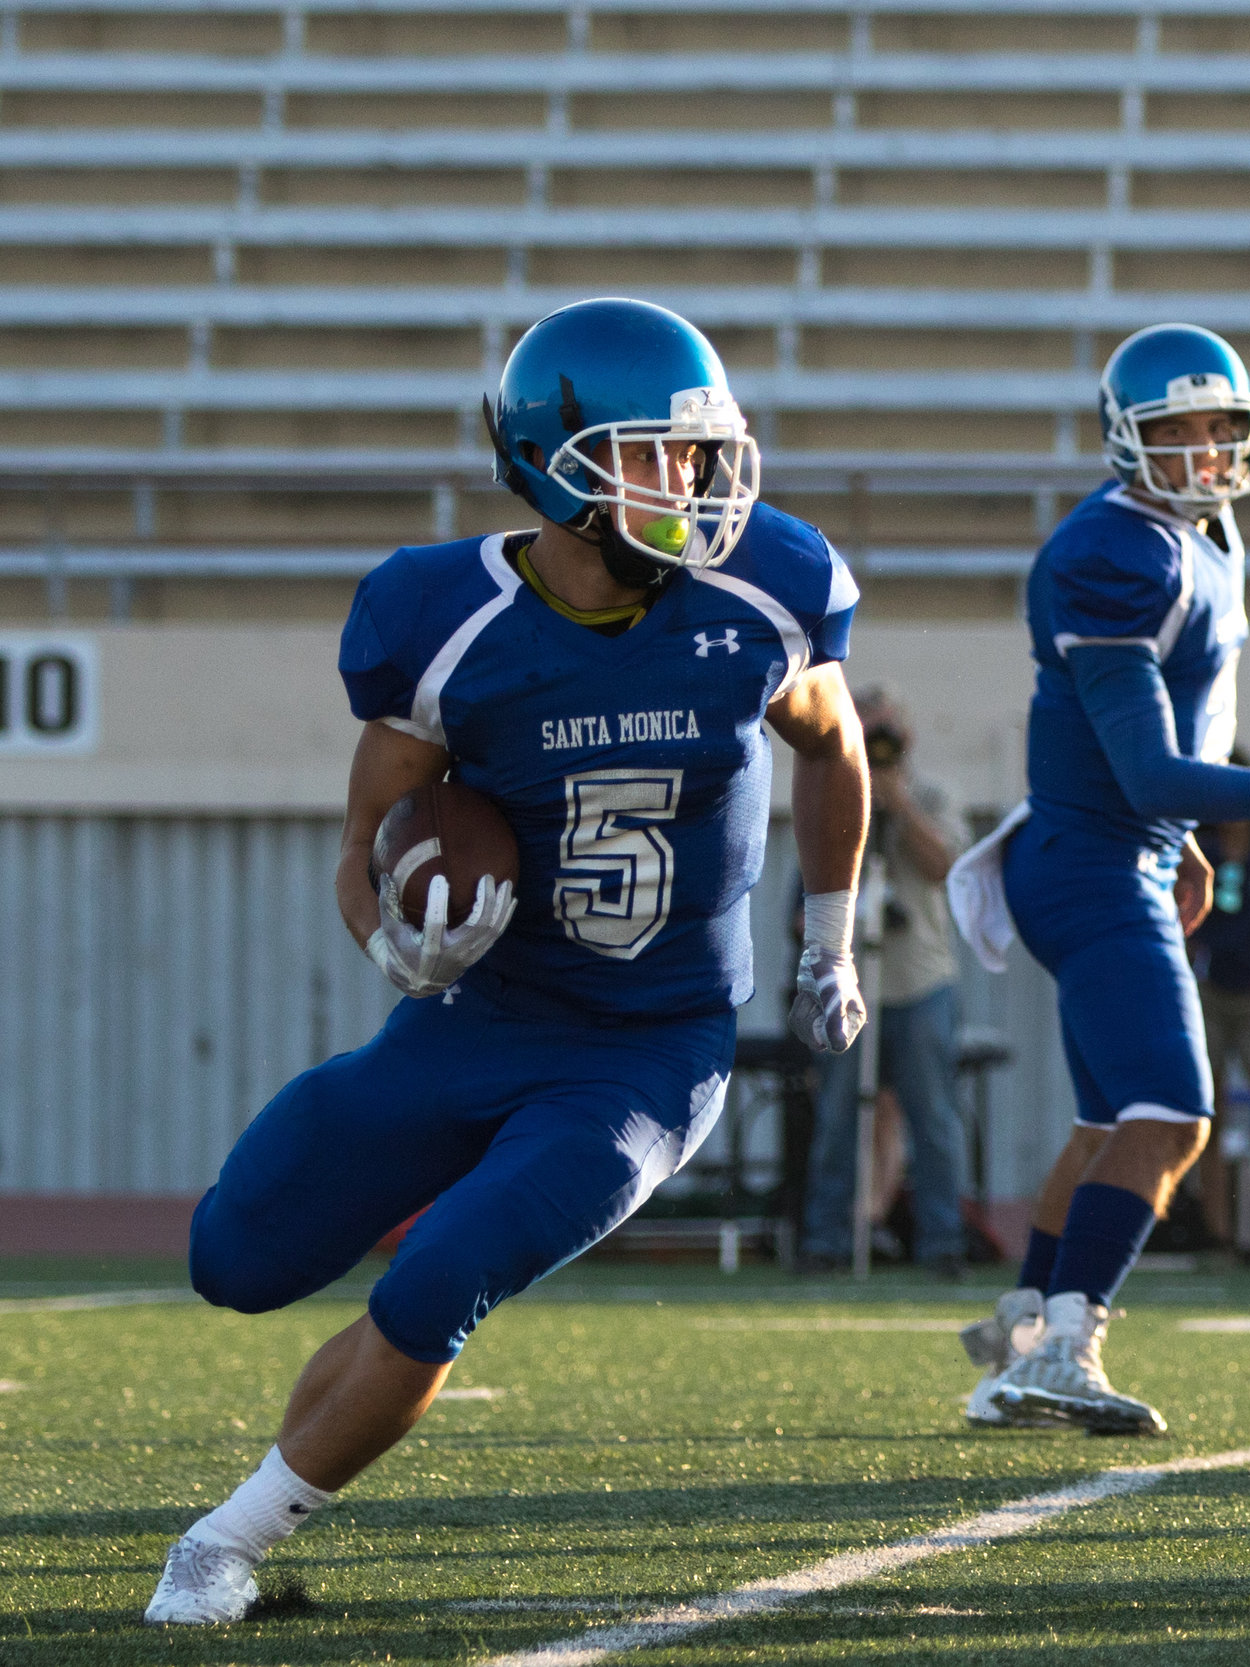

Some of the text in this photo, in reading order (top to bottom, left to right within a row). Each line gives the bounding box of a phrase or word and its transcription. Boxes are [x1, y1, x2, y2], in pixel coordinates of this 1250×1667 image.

[541, 709, 701, 751] SANTA MONICA
[552, 768, 684, 961] 5
